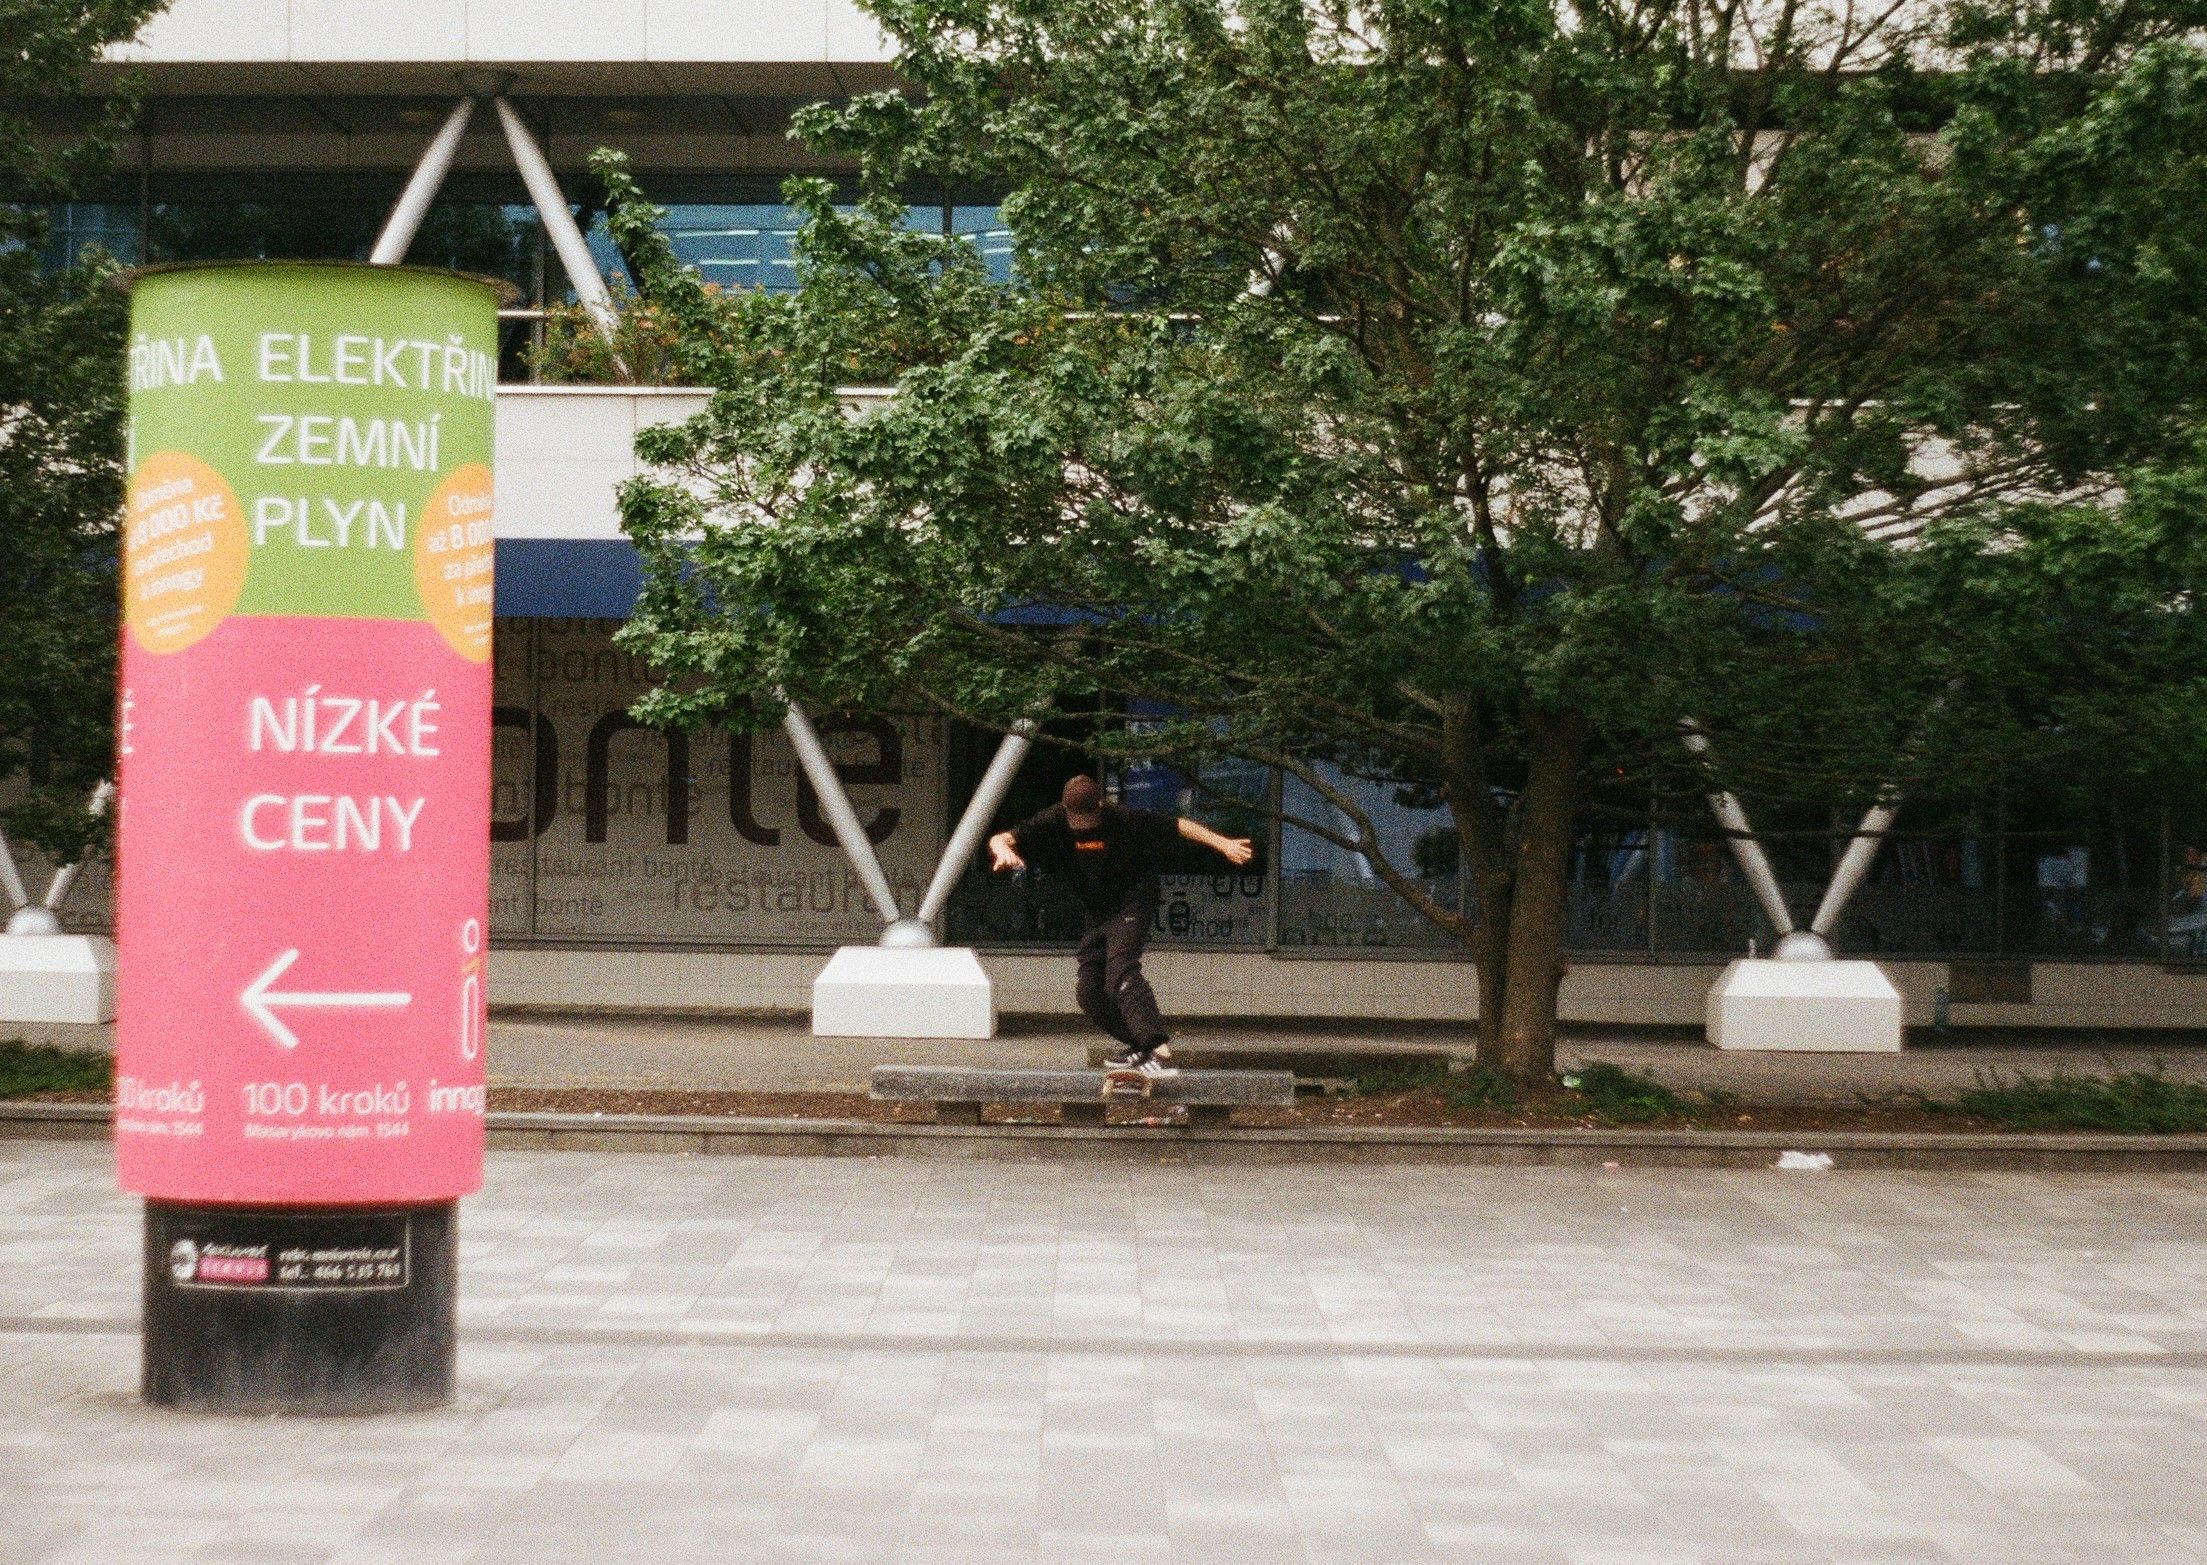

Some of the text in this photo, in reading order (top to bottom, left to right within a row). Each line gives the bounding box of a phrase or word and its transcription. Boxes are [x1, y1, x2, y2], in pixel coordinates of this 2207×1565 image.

[255, 412, 441, 472] ZEMNÍ
[192, 493, 226, 524] Kč
[255, 497, 406, 551] PLYN
[450, 524, 464, 550] 8
[250, 683, 441, 757] NÍZKÉ
[241, 793, 425, 851] CENY
[242, 1080, 411, 1116] 100 kroků
